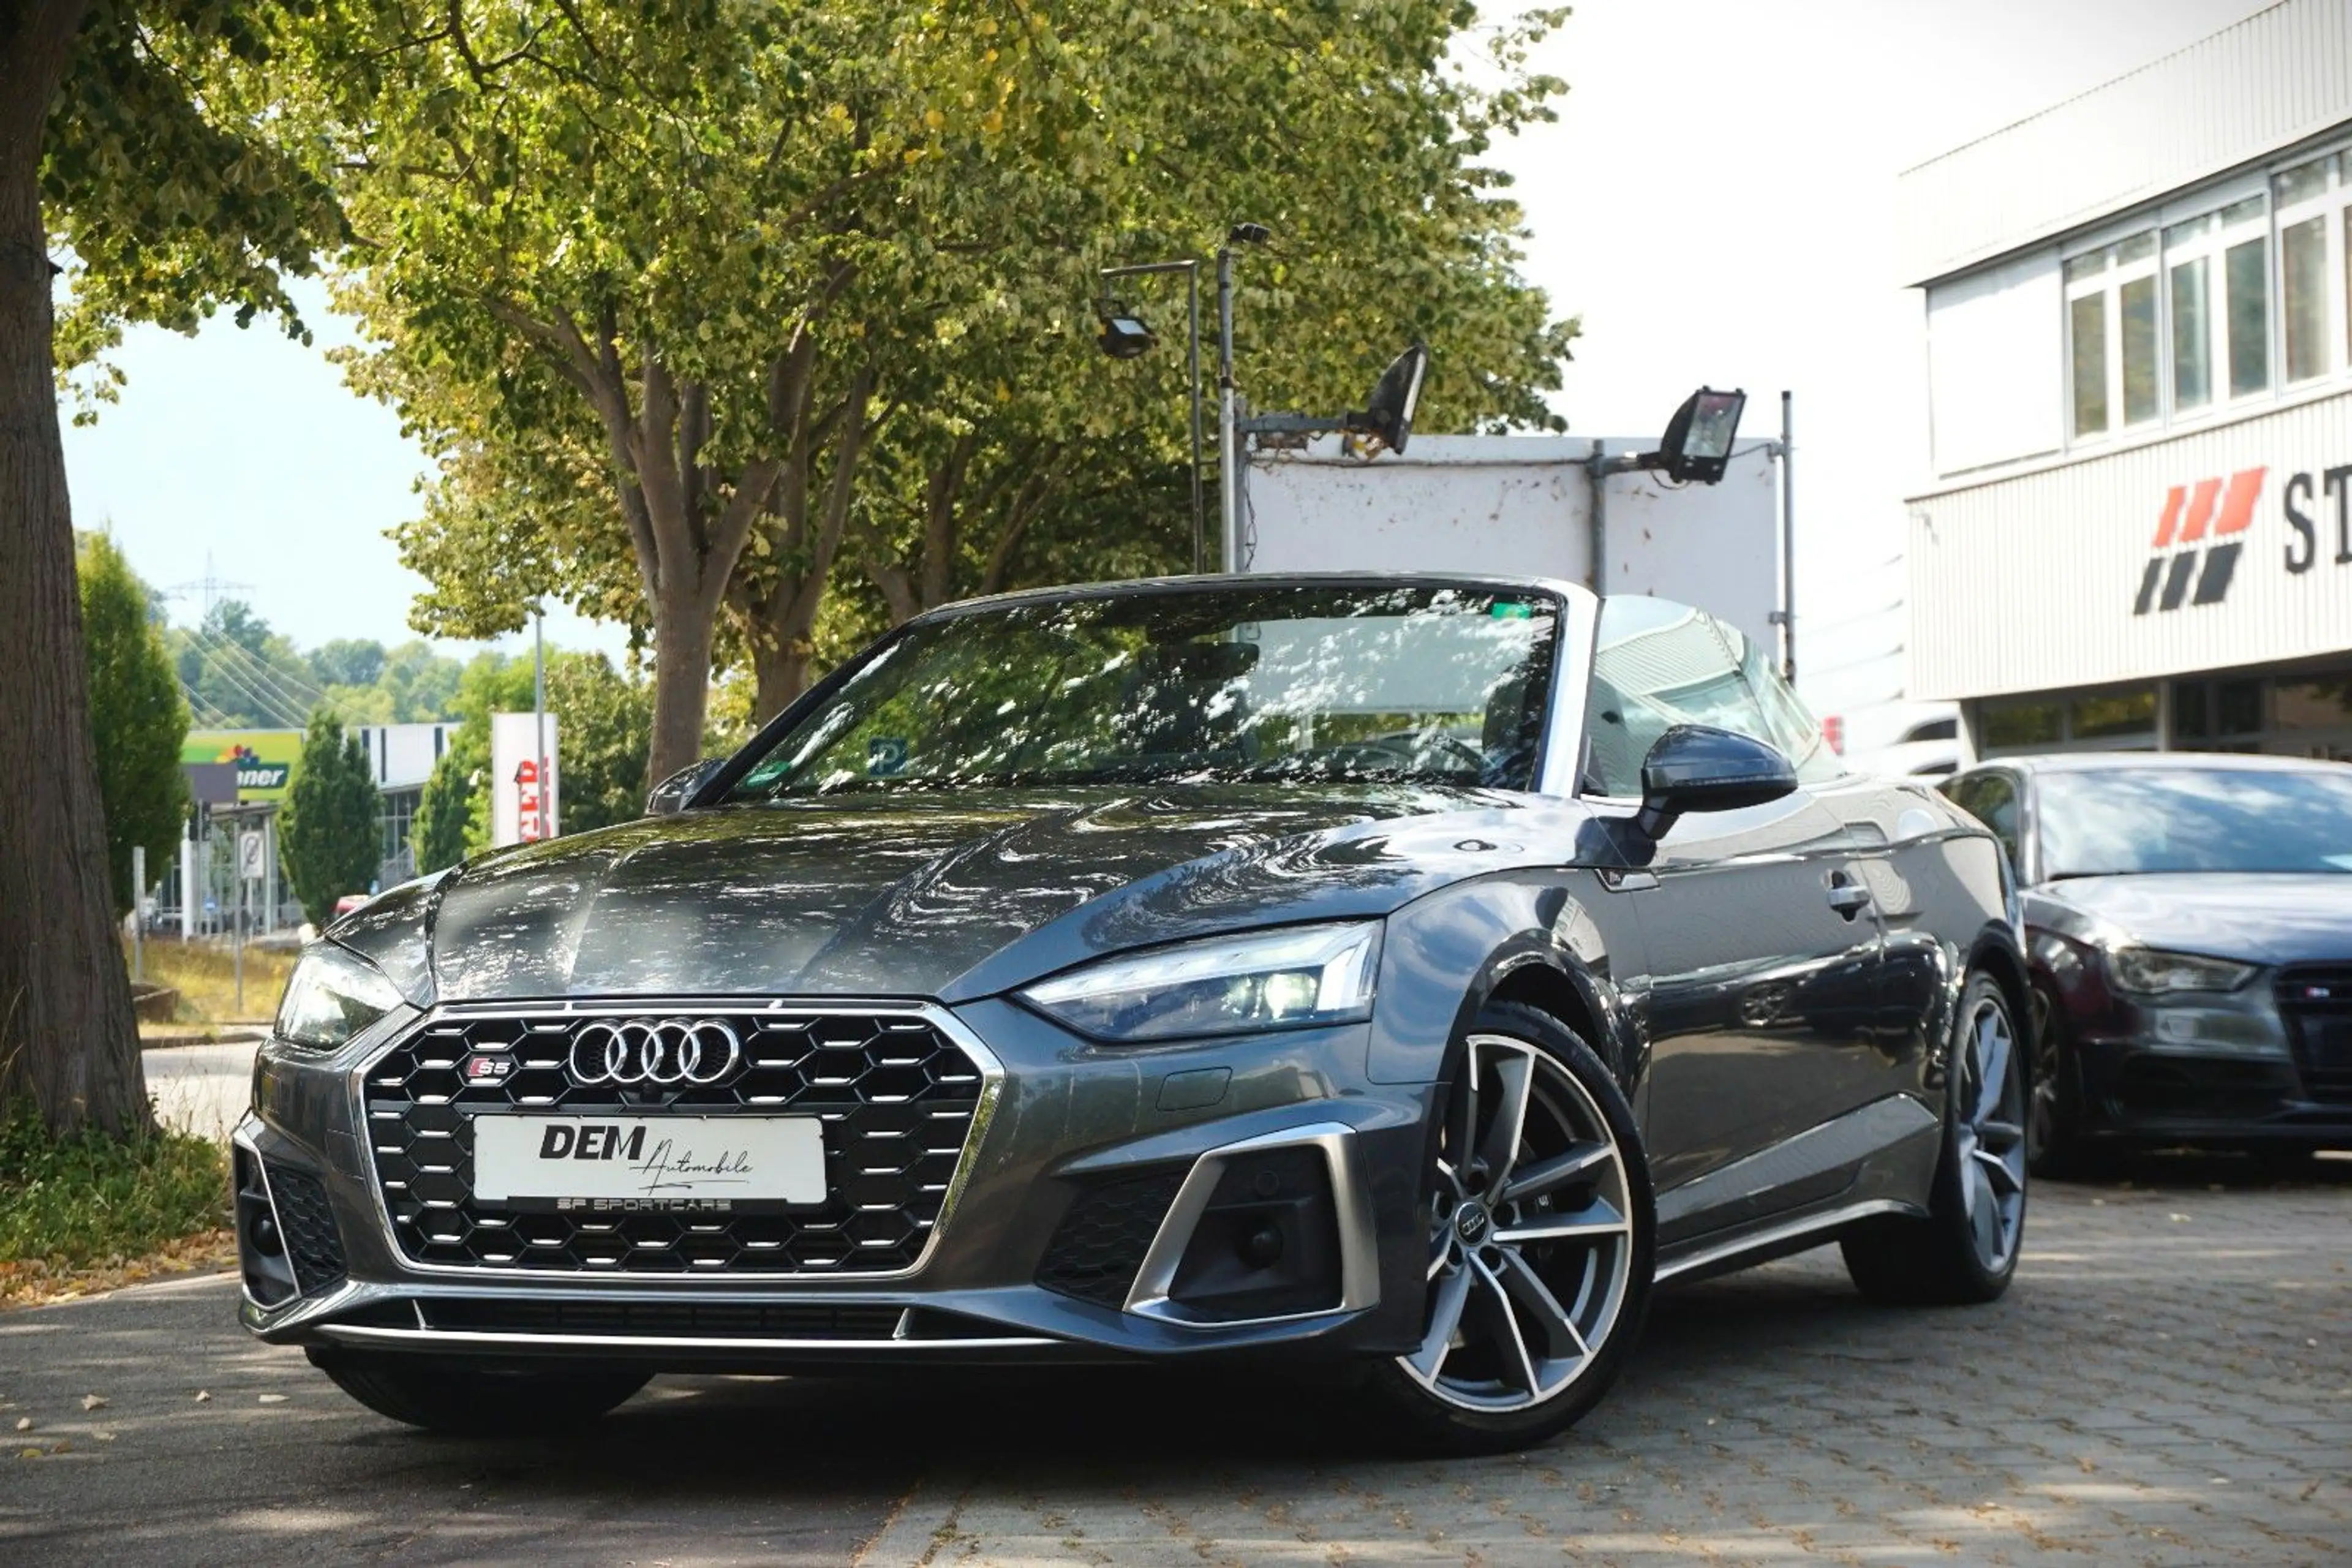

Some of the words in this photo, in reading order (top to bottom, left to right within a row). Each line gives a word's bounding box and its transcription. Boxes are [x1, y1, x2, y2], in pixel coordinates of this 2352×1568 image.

[477, 1061, 511, 1075] S5
[540, 1125, 646, 1160] DEM
[630, 1138, 754, 1196] Automobile
[593, 1199, 732, 1211] SPORTCARS
